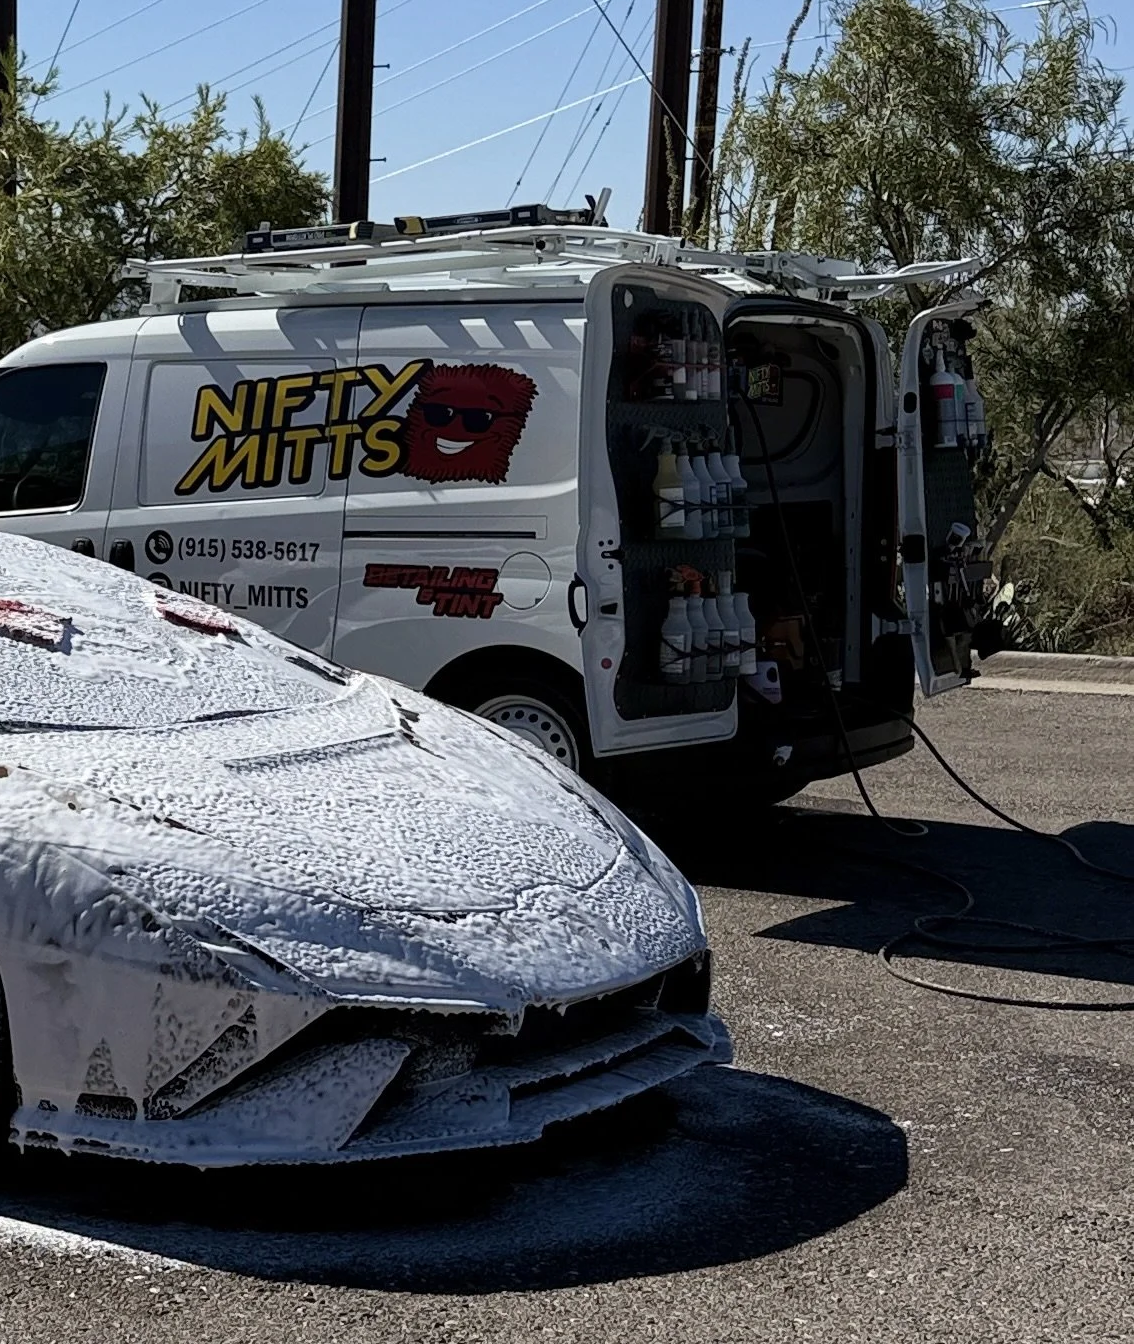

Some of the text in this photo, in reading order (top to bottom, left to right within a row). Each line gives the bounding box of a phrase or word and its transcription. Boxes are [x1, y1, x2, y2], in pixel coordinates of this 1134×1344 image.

[193, 360, 430, 440] NIFTY
[177, 420, 405, 494] MITTS
[178, 537, 320, 563] (915) 538-5617
[365, 565, 498, 591] DETAILING
[178, 581, 309, 610] NIFTY_MITTS
[435, 593, 502, 617] TINT
